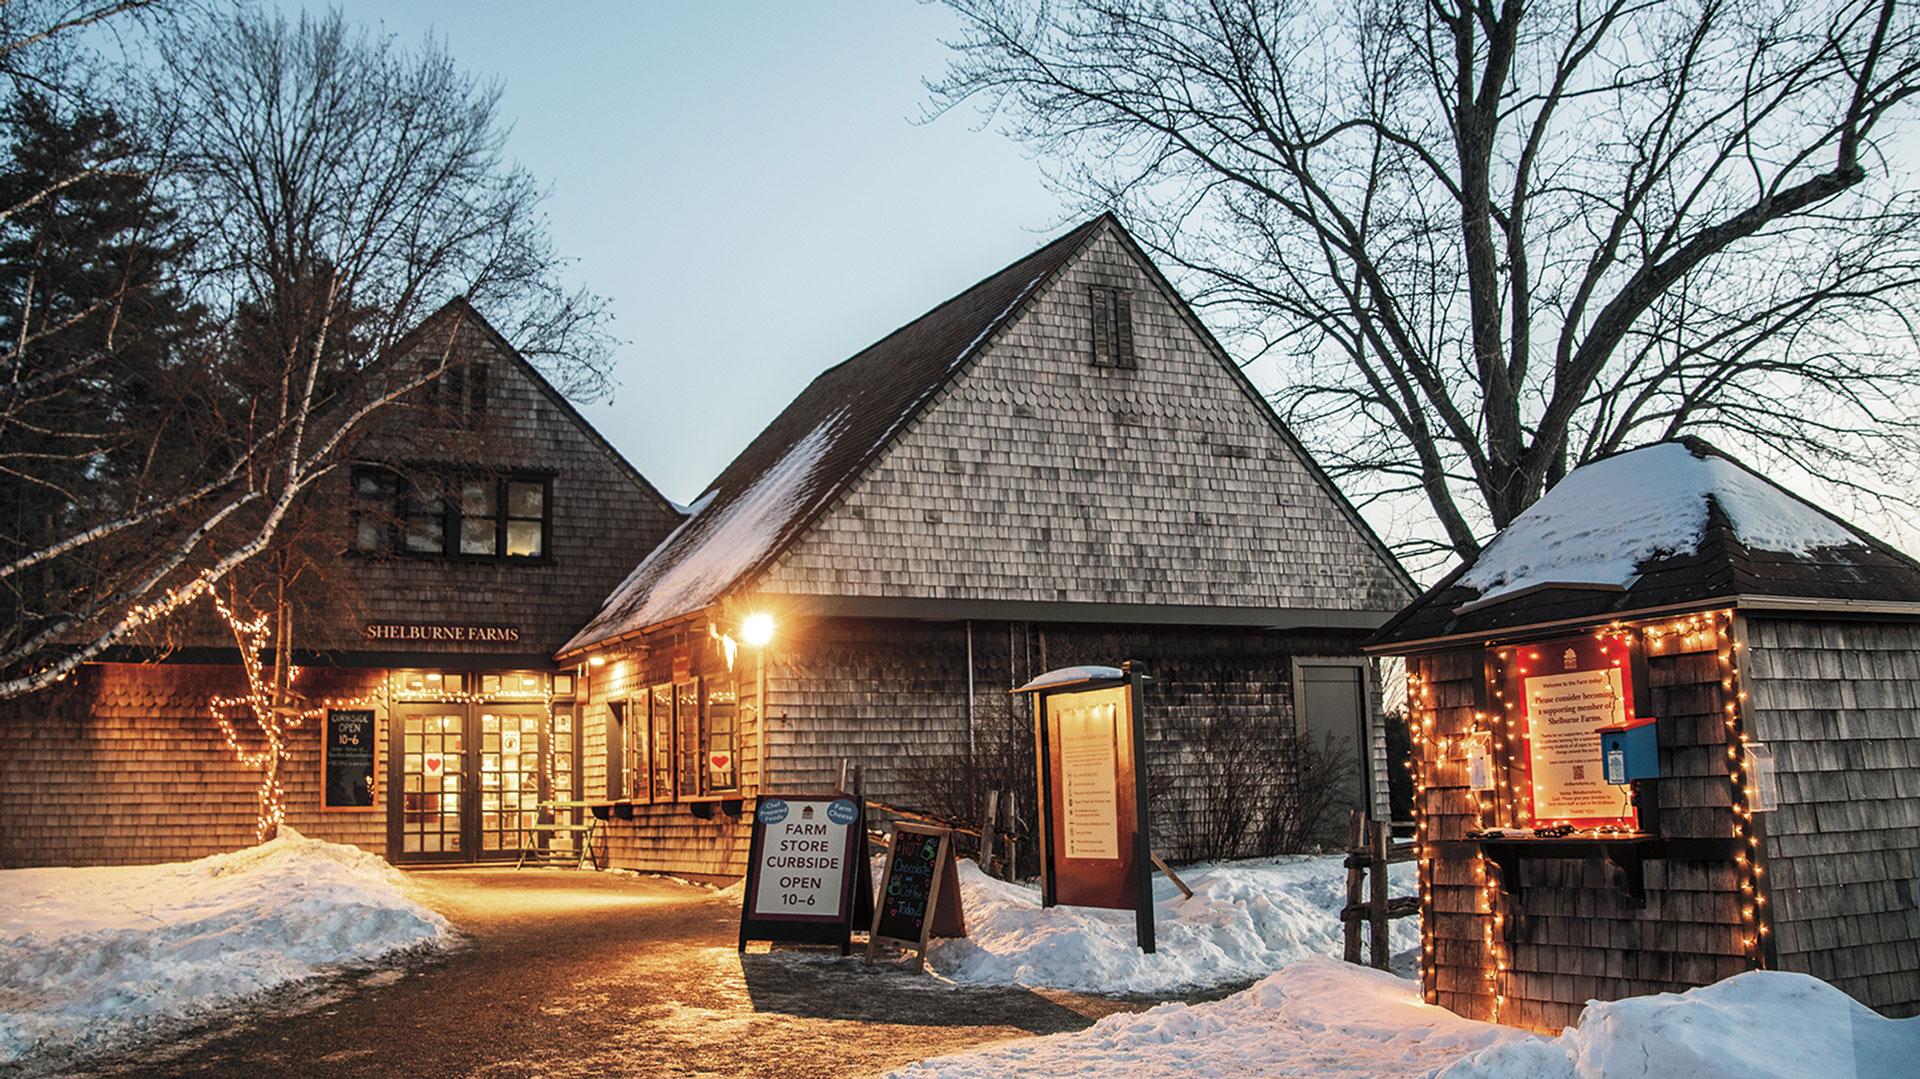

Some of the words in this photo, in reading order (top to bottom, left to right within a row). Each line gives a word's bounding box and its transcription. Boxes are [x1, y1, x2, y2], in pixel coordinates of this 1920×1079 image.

[367, 625, 465, 641] SHELBURNE
[468, 626, 520, 642] FARMS
[1555, 694, 1581, 702] consider
[1583, 692, 1614, 700] becoming
[1543, 706, 1576, 716] supporting
[1577, 703, 1603, 711] member
[1604, 701, 1612, 709] of
[1548, 716, 1579, 725] Shelburne
[338, 723, 360, 732] OPEN
[339, 734, 360, 745] 10-6
[760, 806, 788, 817] Prepared
[834, 803, 852, 812] Farm
[764, 814, 784, 822] Foods
[828, 810, 853, 821] Cheese
[785, 824, 827, 835] FARM
[780, 840, 828, 852] STORE
[902, 842, 922, 856] HOT
[766, 856, 839, 869] CURBSIDE
[894, 858, 931, 875] Chocolate
[779, 876, 822, 889] OPEN
[901, 884, 923, 898] Coffee
